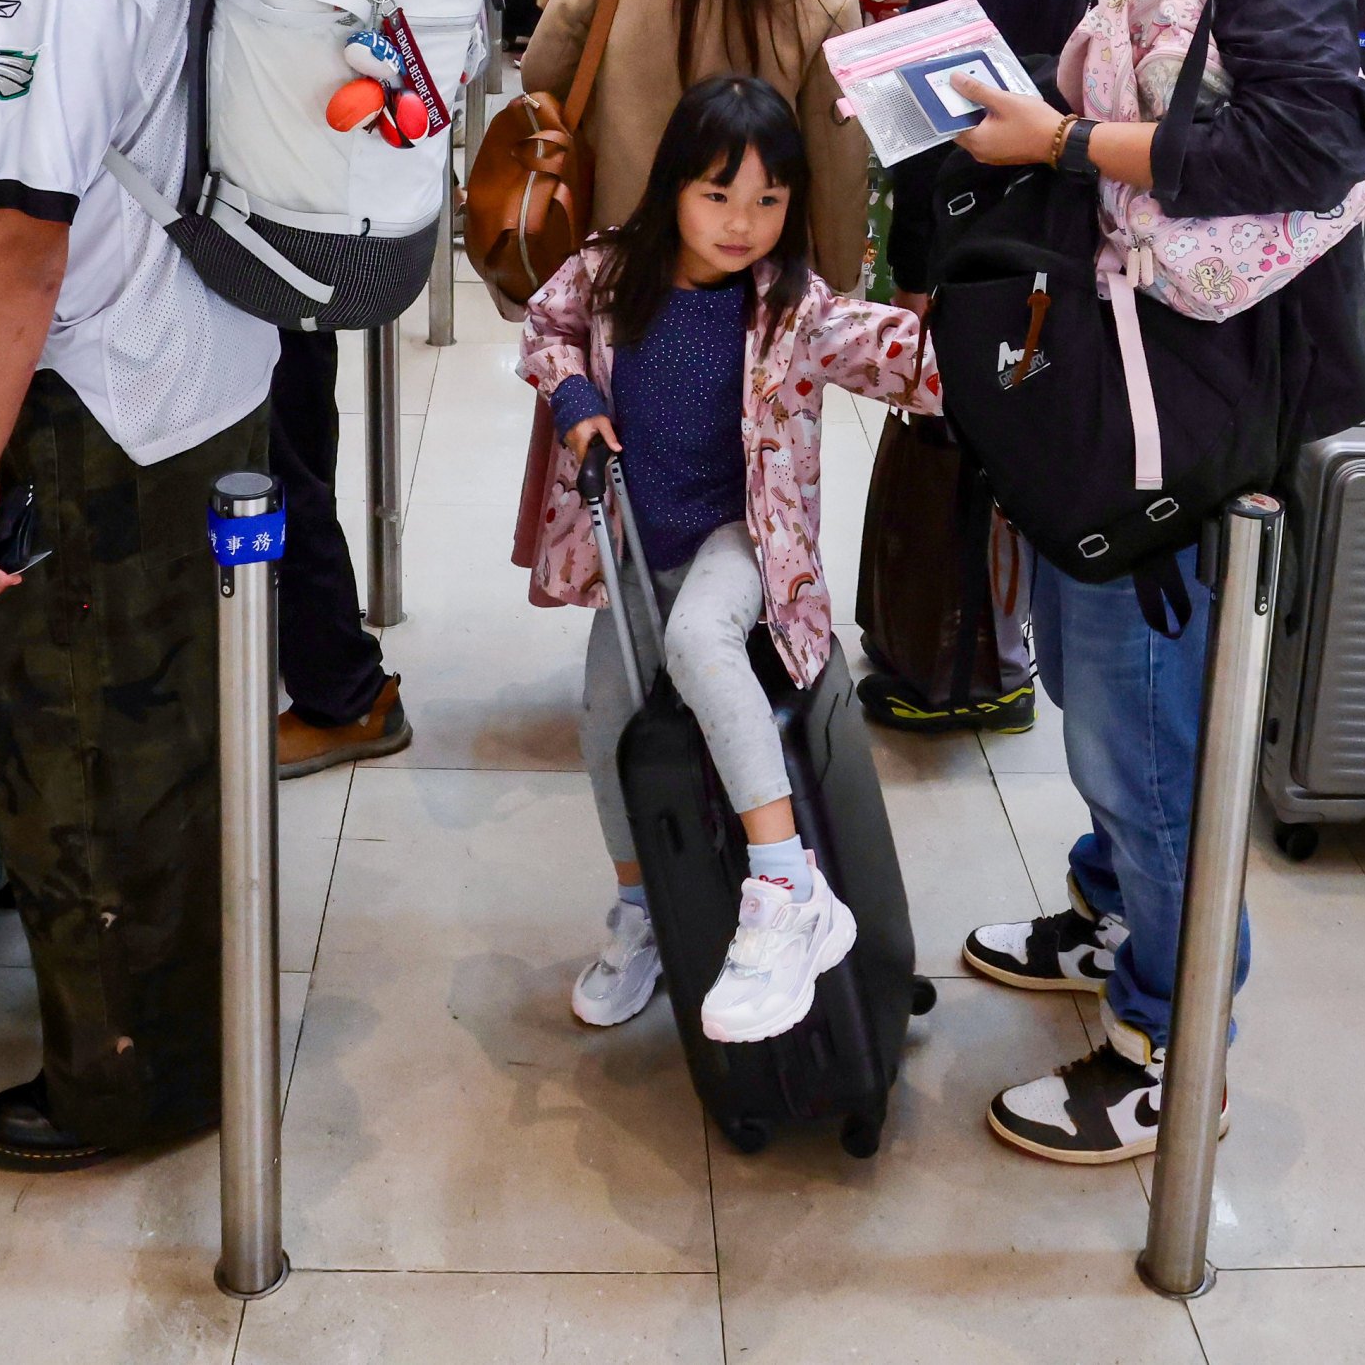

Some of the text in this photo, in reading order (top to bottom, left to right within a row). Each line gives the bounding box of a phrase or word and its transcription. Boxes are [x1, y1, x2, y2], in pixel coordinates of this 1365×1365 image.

[395, 27, 444, 128] REMOVE BEFORE FLIGHT
